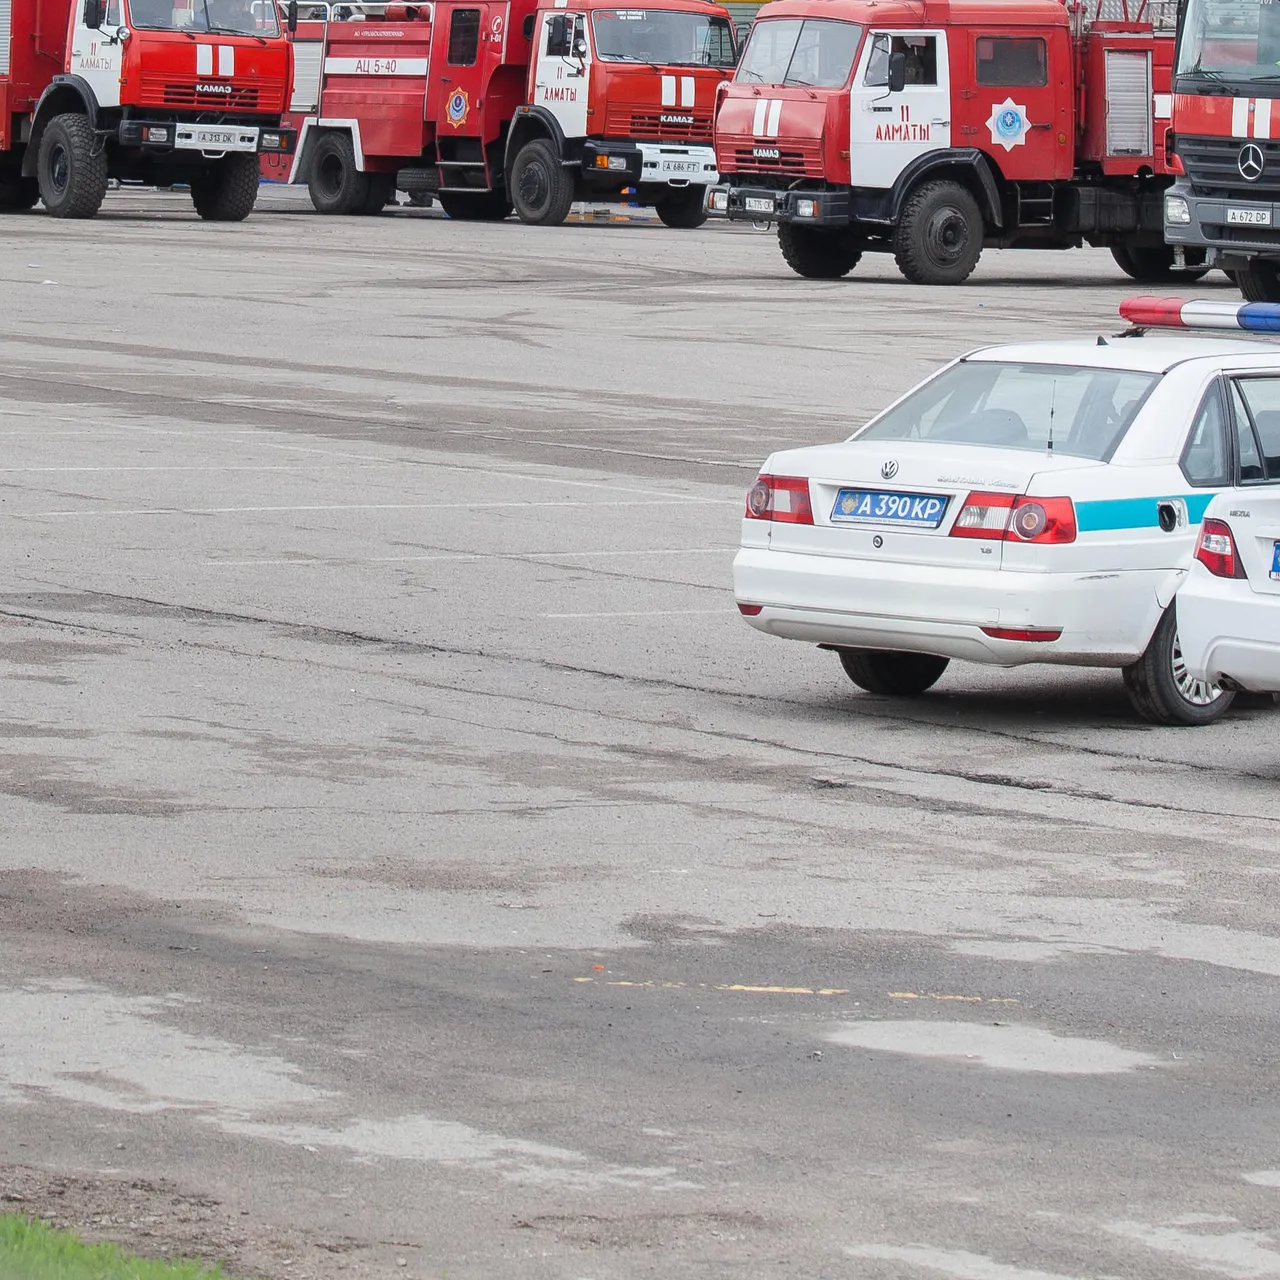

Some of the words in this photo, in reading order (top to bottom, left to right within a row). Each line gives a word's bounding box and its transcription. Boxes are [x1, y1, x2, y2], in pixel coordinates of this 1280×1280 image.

[80, 57, 112, 70] АЛМАТЫ
[355, 59, 370, 74] АЦ
[374, 59, 397, 73] 5-40
[195, 84, 232, 94] КАМАЗ
[544, 87, 577, 101] АЛМАТЫ
[875, 124, 930, 141] АЛМАТЫ
[752, 148, 780, 159] КАМАЗ
[1231, 211, 1236, 221] A
[1239, 212, 1253, 222] 672
[1255, 213, 1267, 222] DP
[857, 494, 871, 514] A
[875, 494, 908, 517] 390
[911, 498, 940, 519] KP
